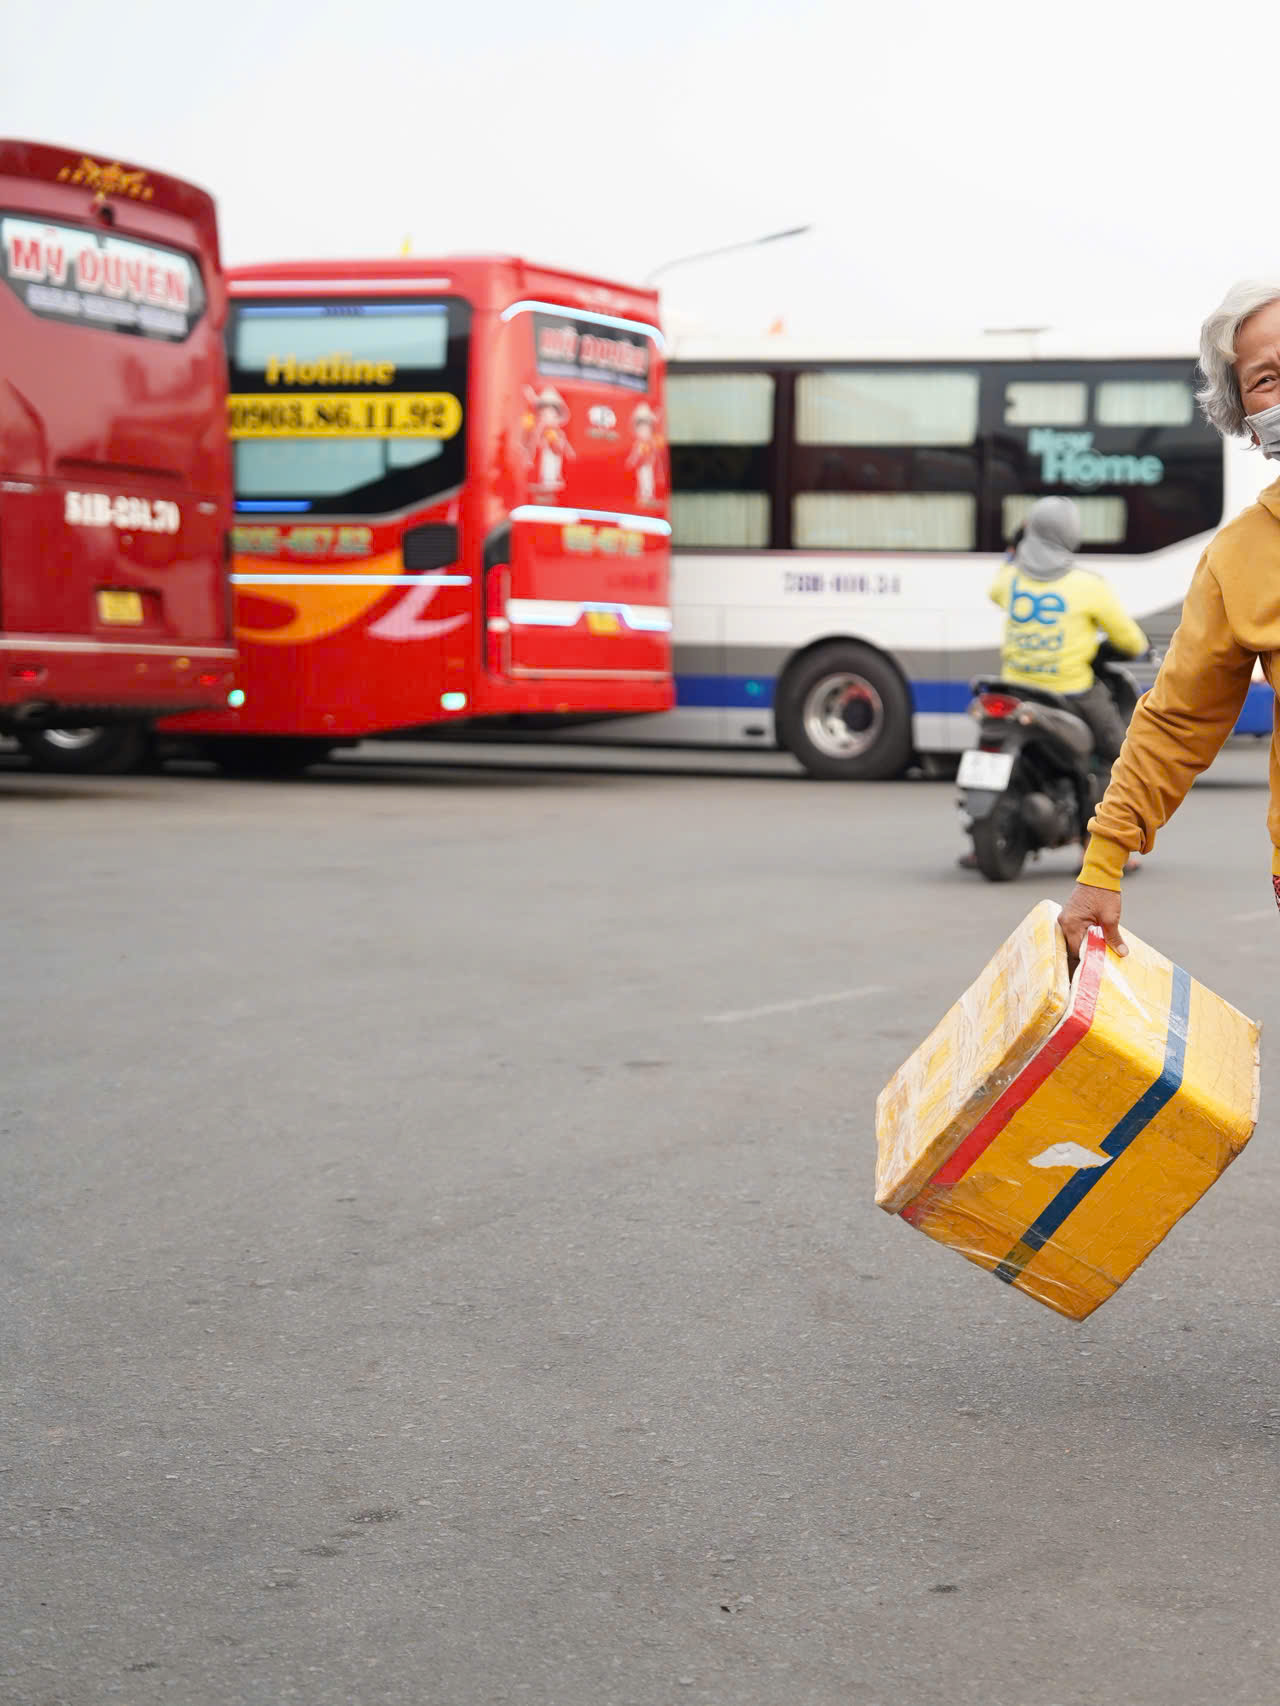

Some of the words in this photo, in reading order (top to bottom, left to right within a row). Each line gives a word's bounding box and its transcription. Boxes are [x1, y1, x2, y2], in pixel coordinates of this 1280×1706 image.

[265, 353, 397, 386] Hotline
[1042, 449, 1165, 487] Home
[1010, 577, 1066, 625] be
